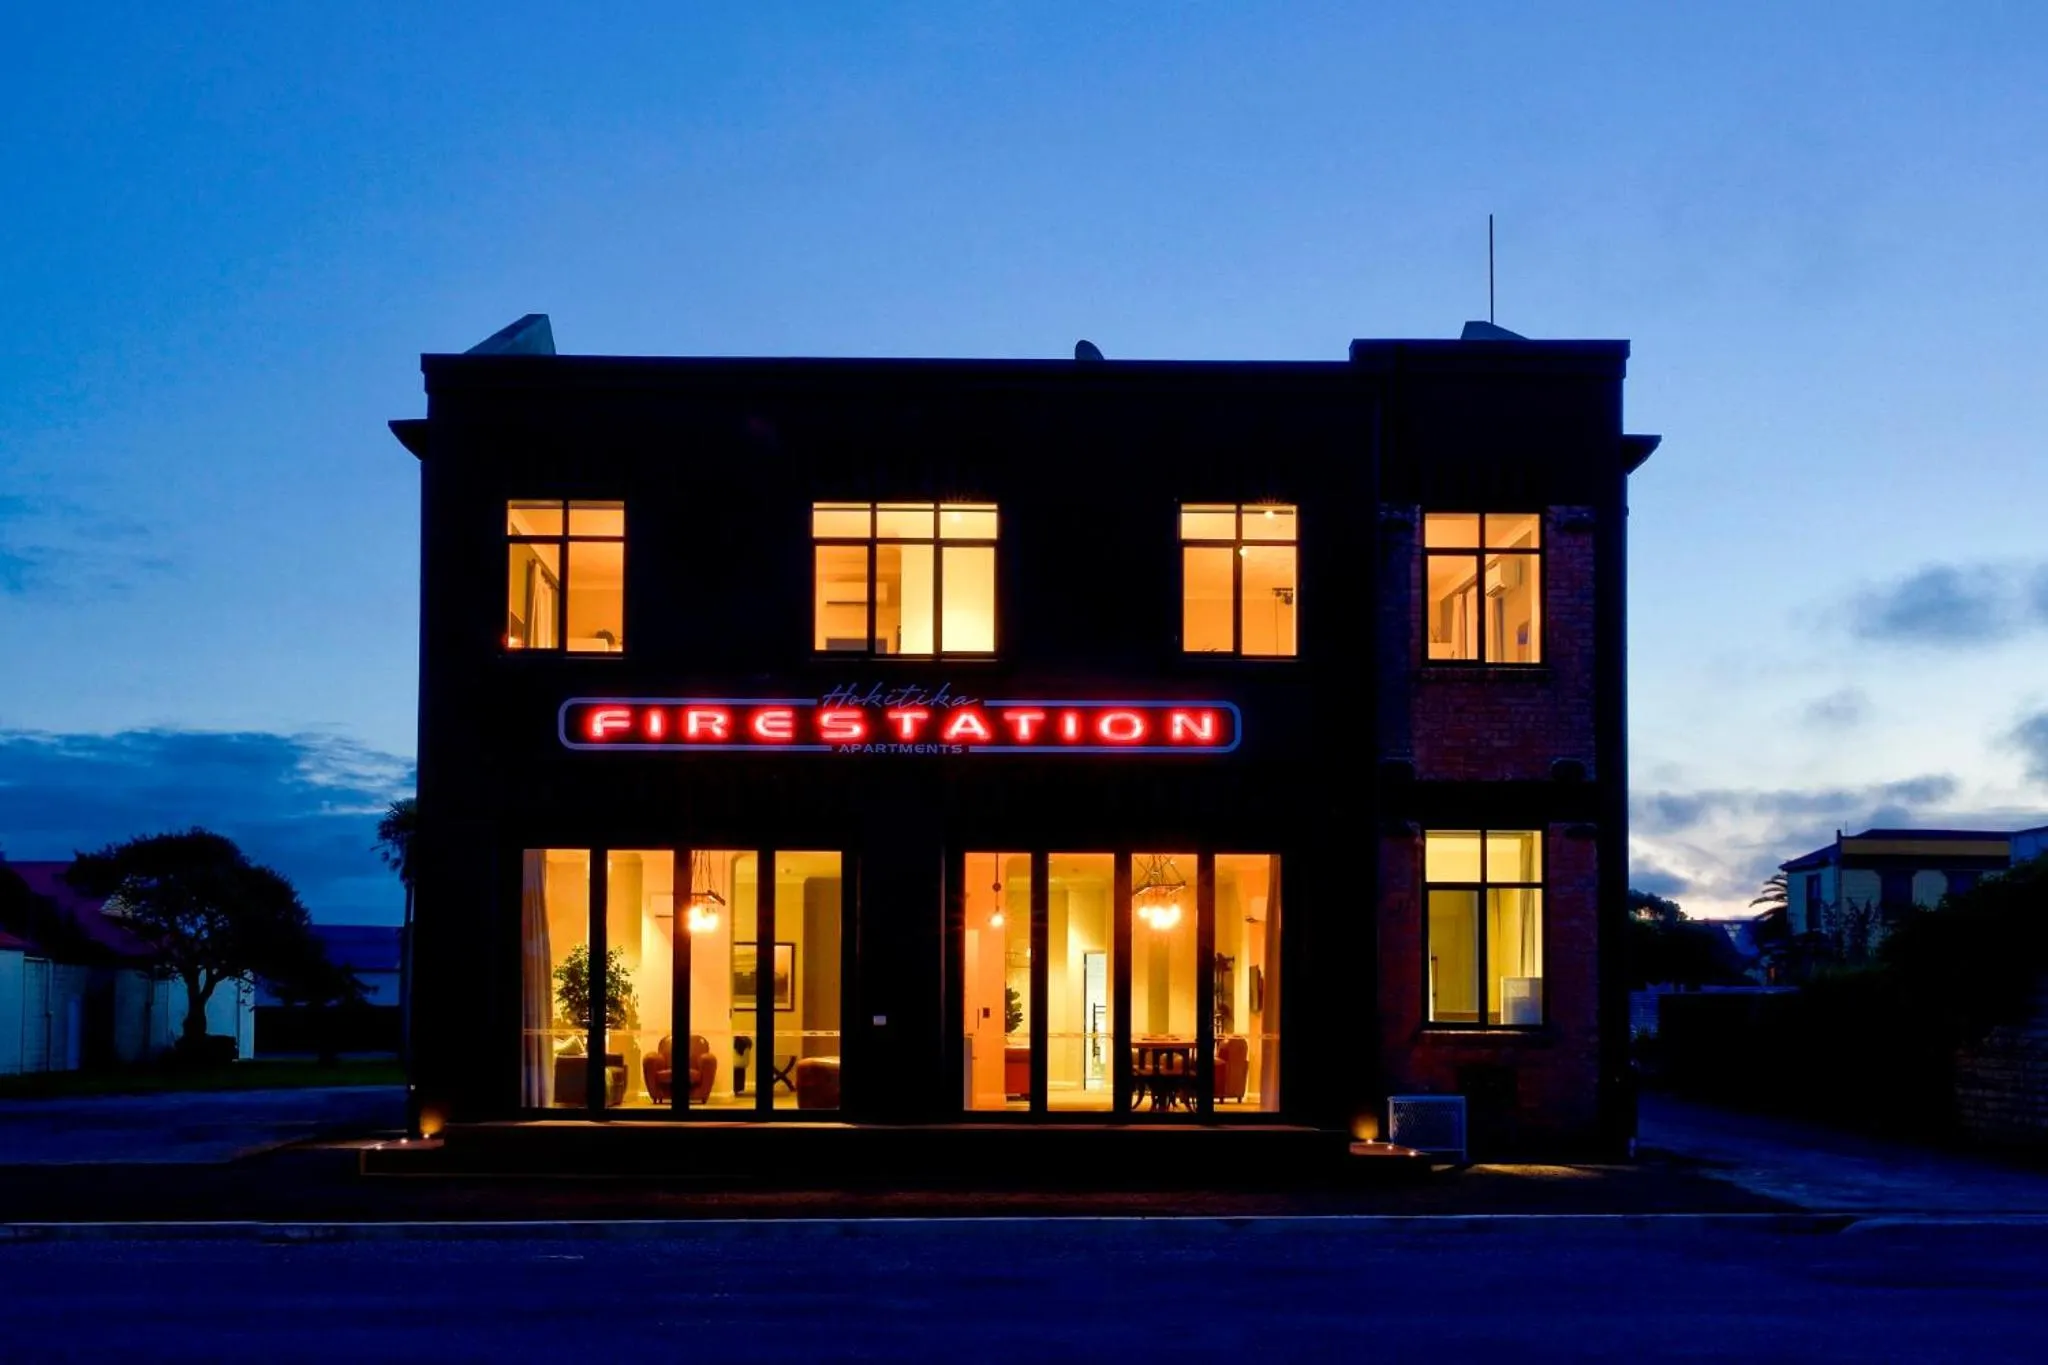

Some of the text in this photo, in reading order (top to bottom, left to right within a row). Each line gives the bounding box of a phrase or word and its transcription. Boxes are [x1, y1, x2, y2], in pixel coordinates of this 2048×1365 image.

[822, 682, 979, 709] Hokitika
[590, 709, 1214, 741] FIRESTATION
[838, 743, 963, 754] APARTMENTS
